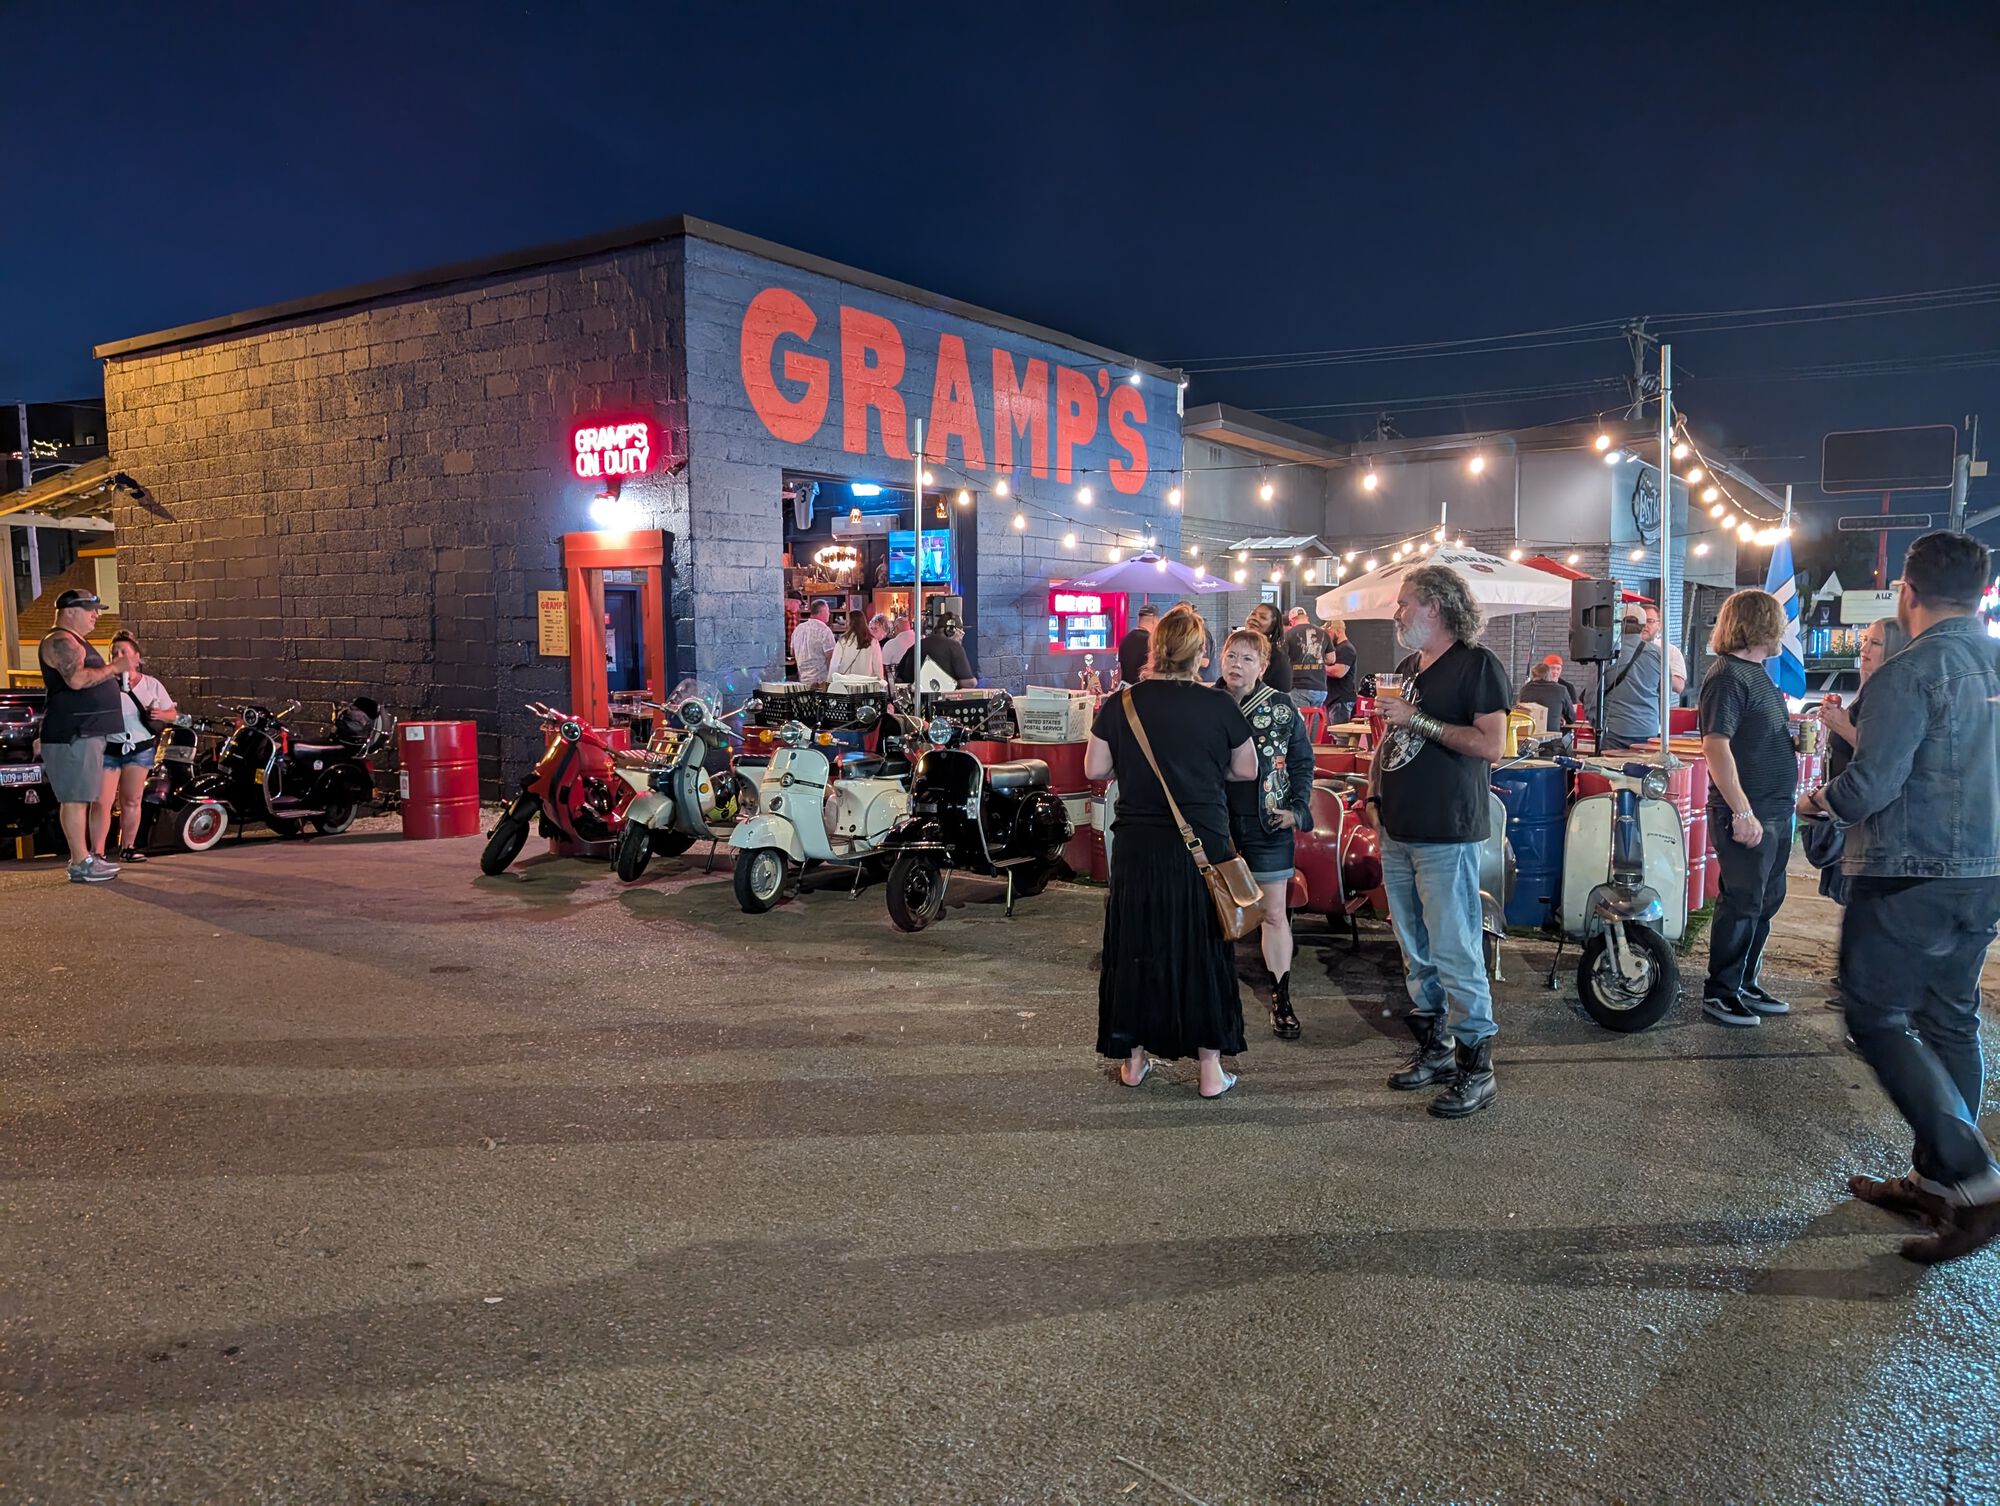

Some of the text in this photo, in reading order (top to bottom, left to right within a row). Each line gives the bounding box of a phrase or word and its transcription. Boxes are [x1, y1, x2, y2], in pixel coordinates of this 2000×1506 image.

[740, 287, 1149, 495] GRAMP'S
[576, 446, 650, 477] ON DUTY
[800, 489, 807, 504] 3
